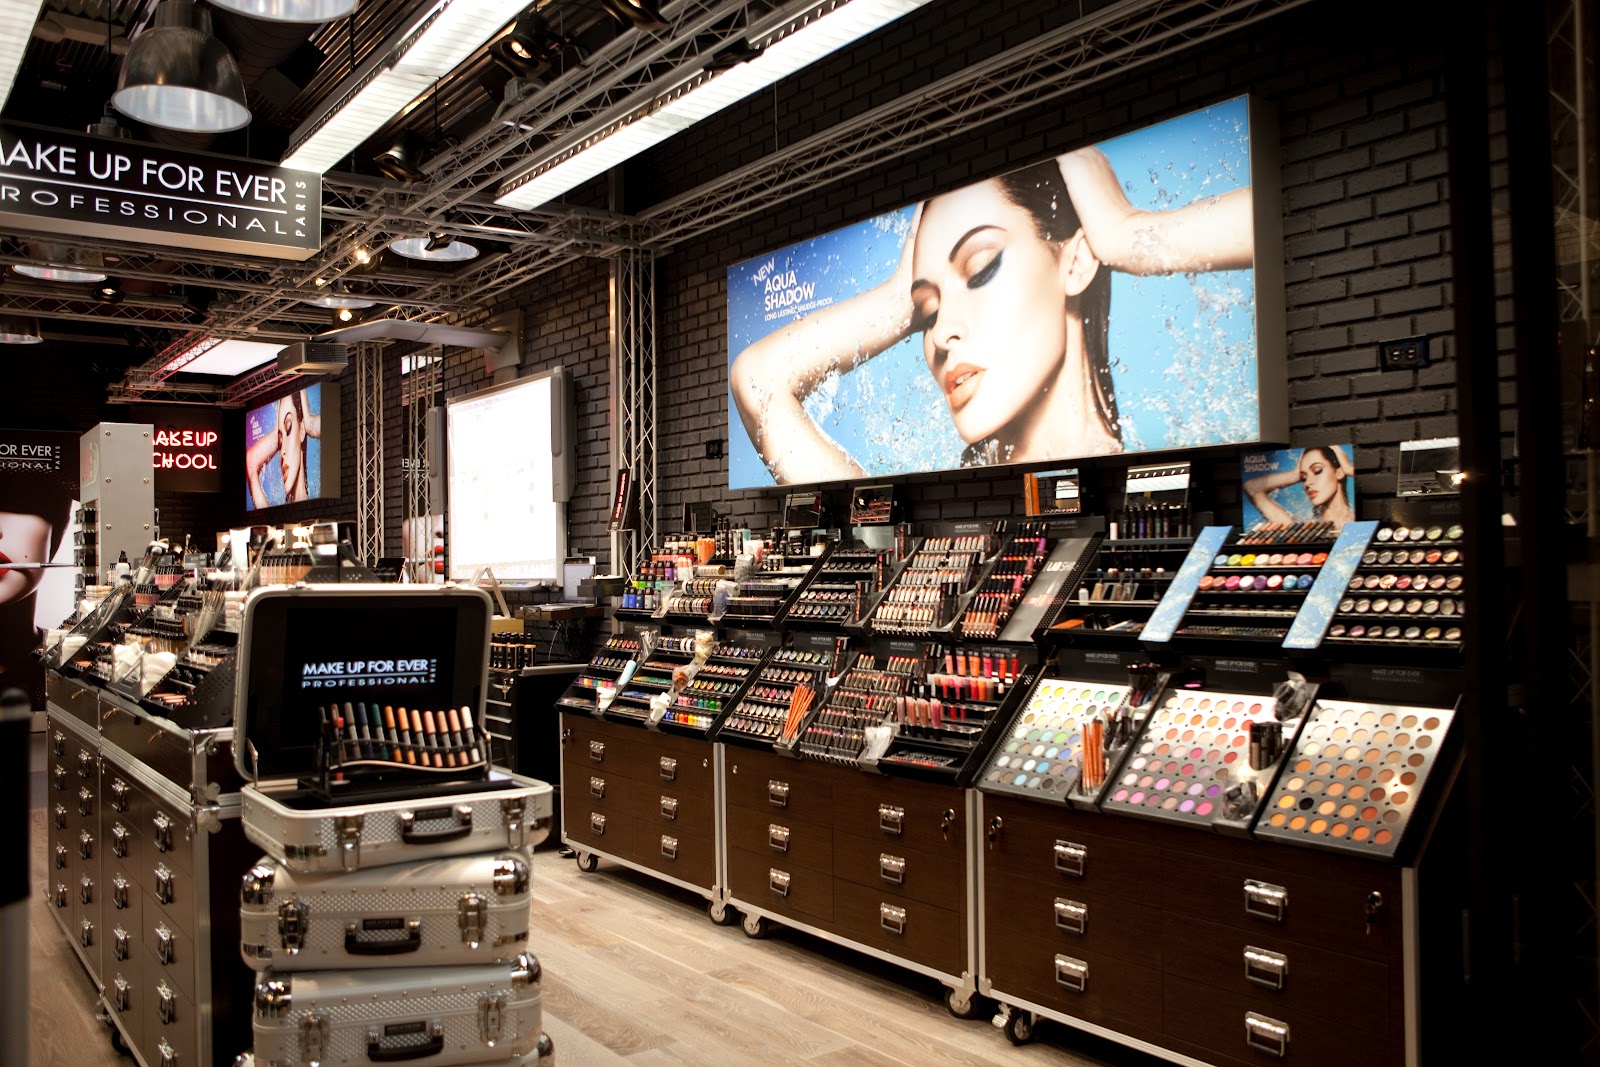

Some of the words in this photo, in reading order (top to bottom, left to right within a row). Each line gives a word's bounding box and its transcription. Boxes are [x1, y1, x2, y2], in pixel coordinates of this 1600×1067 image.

[89, 150, 131, 181] UP
[142, 158, 205, 193] FOR
[216, 169, 288, 204] EVER
[1, 184, 288, 236] ROFESSIONAL
[295, 181, 307, 238] PARIS
[752, 256, 775, 287] NEW
[764, 269, 798, 295] AQUA
[764, 282, 816, 312] SHADOW
[764, 311, 778, 322] LONG
[151, 430, 218, 447] AKEUP
[0, 443, 18, 456] OR
[21, 444, 53, 457] EVER
[2, 461, 53, 470] IONAL
[151, 451, 218, 470] CHOOL
[1243, 454, 1267, 465] AQUA
[1244, 461, 1279, 473] SHADOW
[303, 661, 345, 675] MAKE
[346, 660, 366, 674] UP
[367, 659, 395, 673] FOR
[396, 658, 429, 672] EVER
[301, 676, 428, 689] PROFESSIONAL
